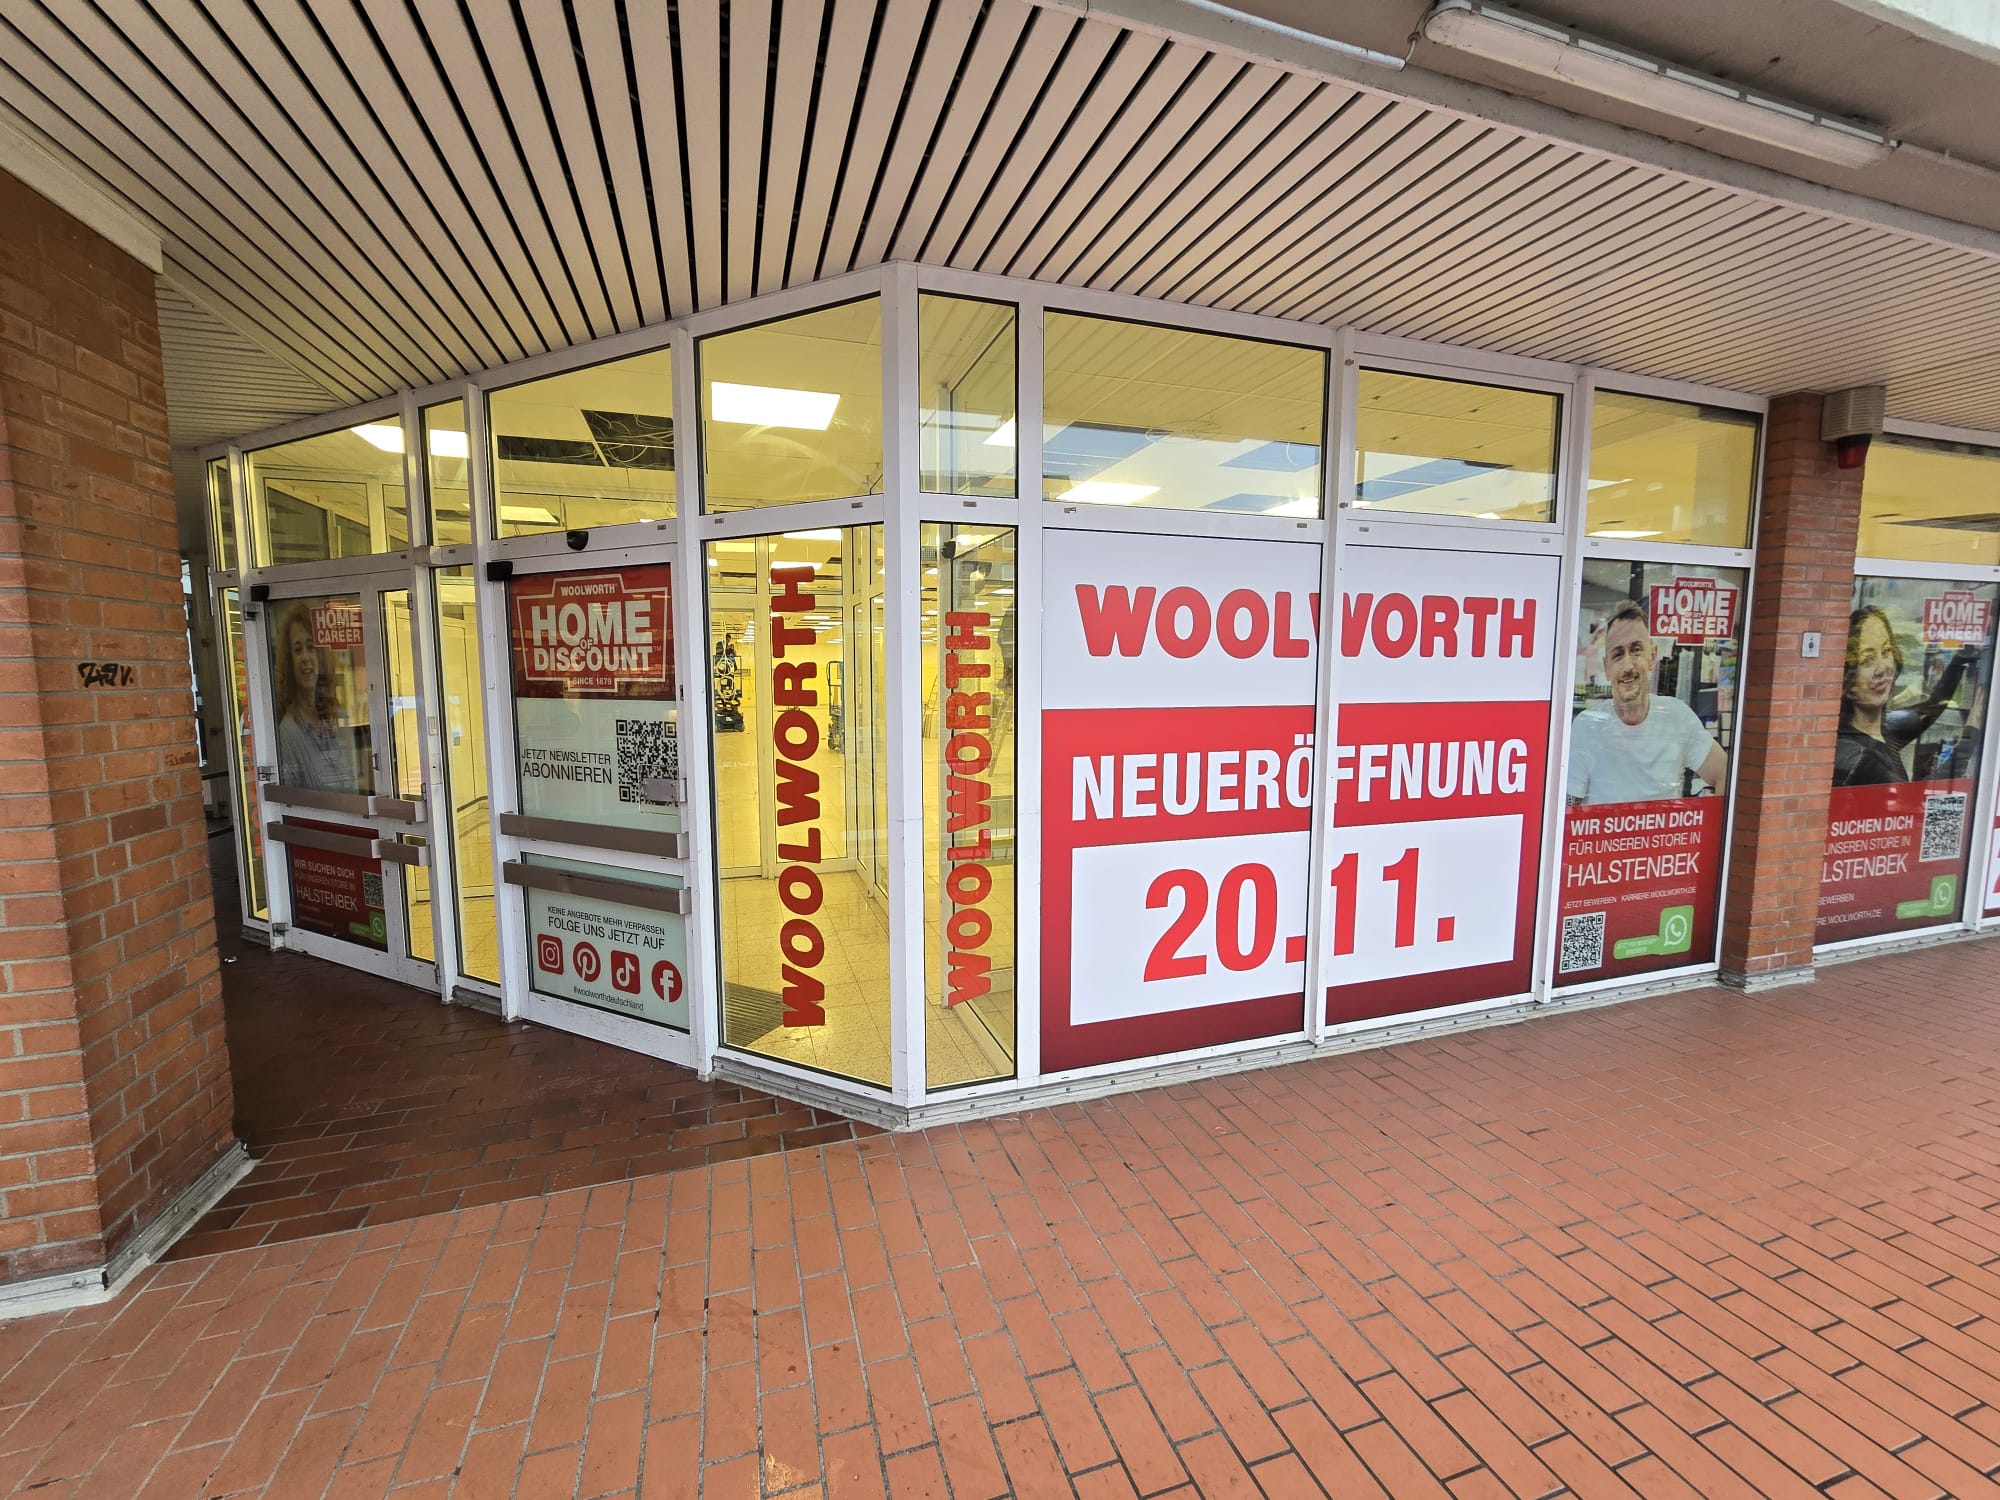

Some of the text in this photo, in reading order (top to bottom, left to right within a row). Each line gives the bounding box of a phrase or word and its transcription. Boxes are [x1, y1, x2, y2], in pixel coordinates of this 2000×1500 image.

[560, 583, 615, 597] WOOLWORTH
[1657, 588, 1731, 616] HOME
[316, 609, 361, 630] HOME
[530, 599, 653, 646] HOME
[1075, 584, 1537, 659] WOOLWORTH
[1656, 615, 1729, 635] CAREER
[1929, 600, 1986, 625] HOME
[318, 629, 361, 644] CAREER
[580, 638, 593, 650] OF
[1927, 624, 1983, 641] CAREER
[533, 646, 653, 672] DISCOUNT
[573, 677, 594, 685] SINCE
[521, 748, 611, 765] JETZT NEWSLETTER
[523, 762, 612, 784] ABONNIEREN
[1072, 733, 1529, 822] NEUERÖFFNUNG
[771, 565, 826, 1028] WOOLWORTH
[945, 611, 993, 1008] WOOLWORTH
[1570, 810, 1703, 836] WIR SUCHEN DICH
[1831, 815, 1913, 837] SUCHEN DICH
[1568, 831, 1701, 856] FÜR UNSEREN STORE IN
[1869, 836, 1900, 851] STORE
[1901, 835, 1911, 847] IN
[294, 858, 355, 879] WIR SUCHEN DICH
[1567, 851, 1700, 888] HALSTENBEK
[1820, 852, 1909, 883] LSTENBEK
[296, 884, 358, 912] HALSTENBEK
[1564, 899, 1583, 909] JETZT
[547, 906, 665, 936] KEINE ANGEBOTE MEHR VERPASSEN
[1143, 847, 1456, 983] 20.11.
[548, 916, 665, 950] FOLGE UNS JETZT AUF
[573, 985, 644, 1011] #woolworthdeutschland
